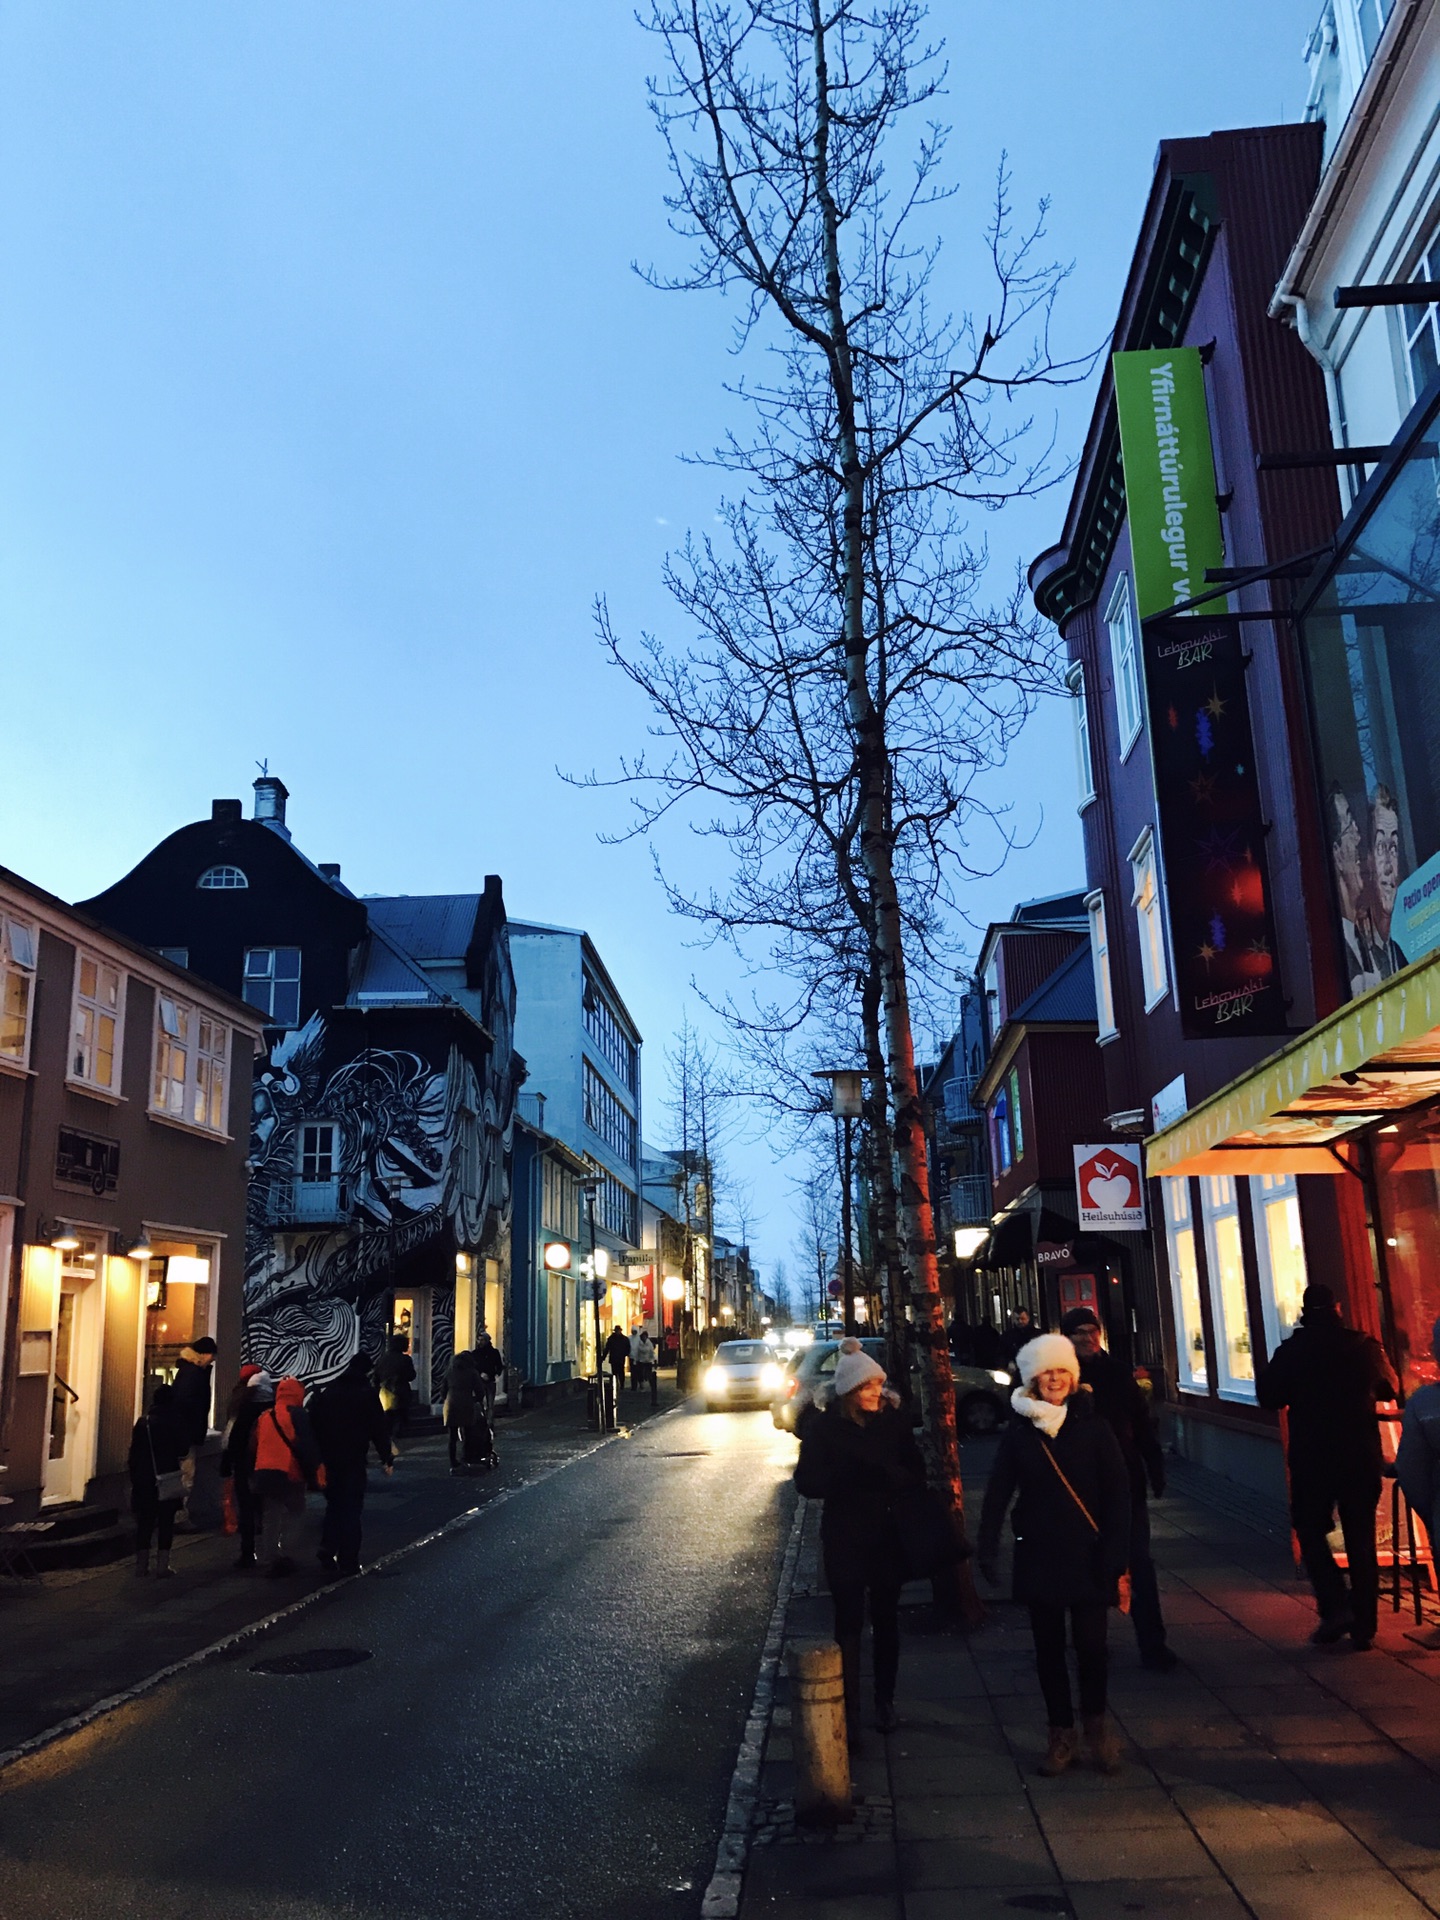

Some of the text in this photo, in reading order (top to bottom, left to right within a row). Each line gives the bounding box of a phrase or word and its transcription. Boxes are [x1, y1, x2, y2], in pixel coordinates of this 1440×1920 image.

[1150, 360, 1190, 573] Yfirnáttúrulegur
[1157, 628, 1228, 658] Lebowski
[1176, 642, 1213, 670] BAR
[1194, 977, 1270, 1010] Lebowski
[1214, 993, 1254, 1024] BAR
[1081, 1211, 1143, 1221] Heilsuhúsið
